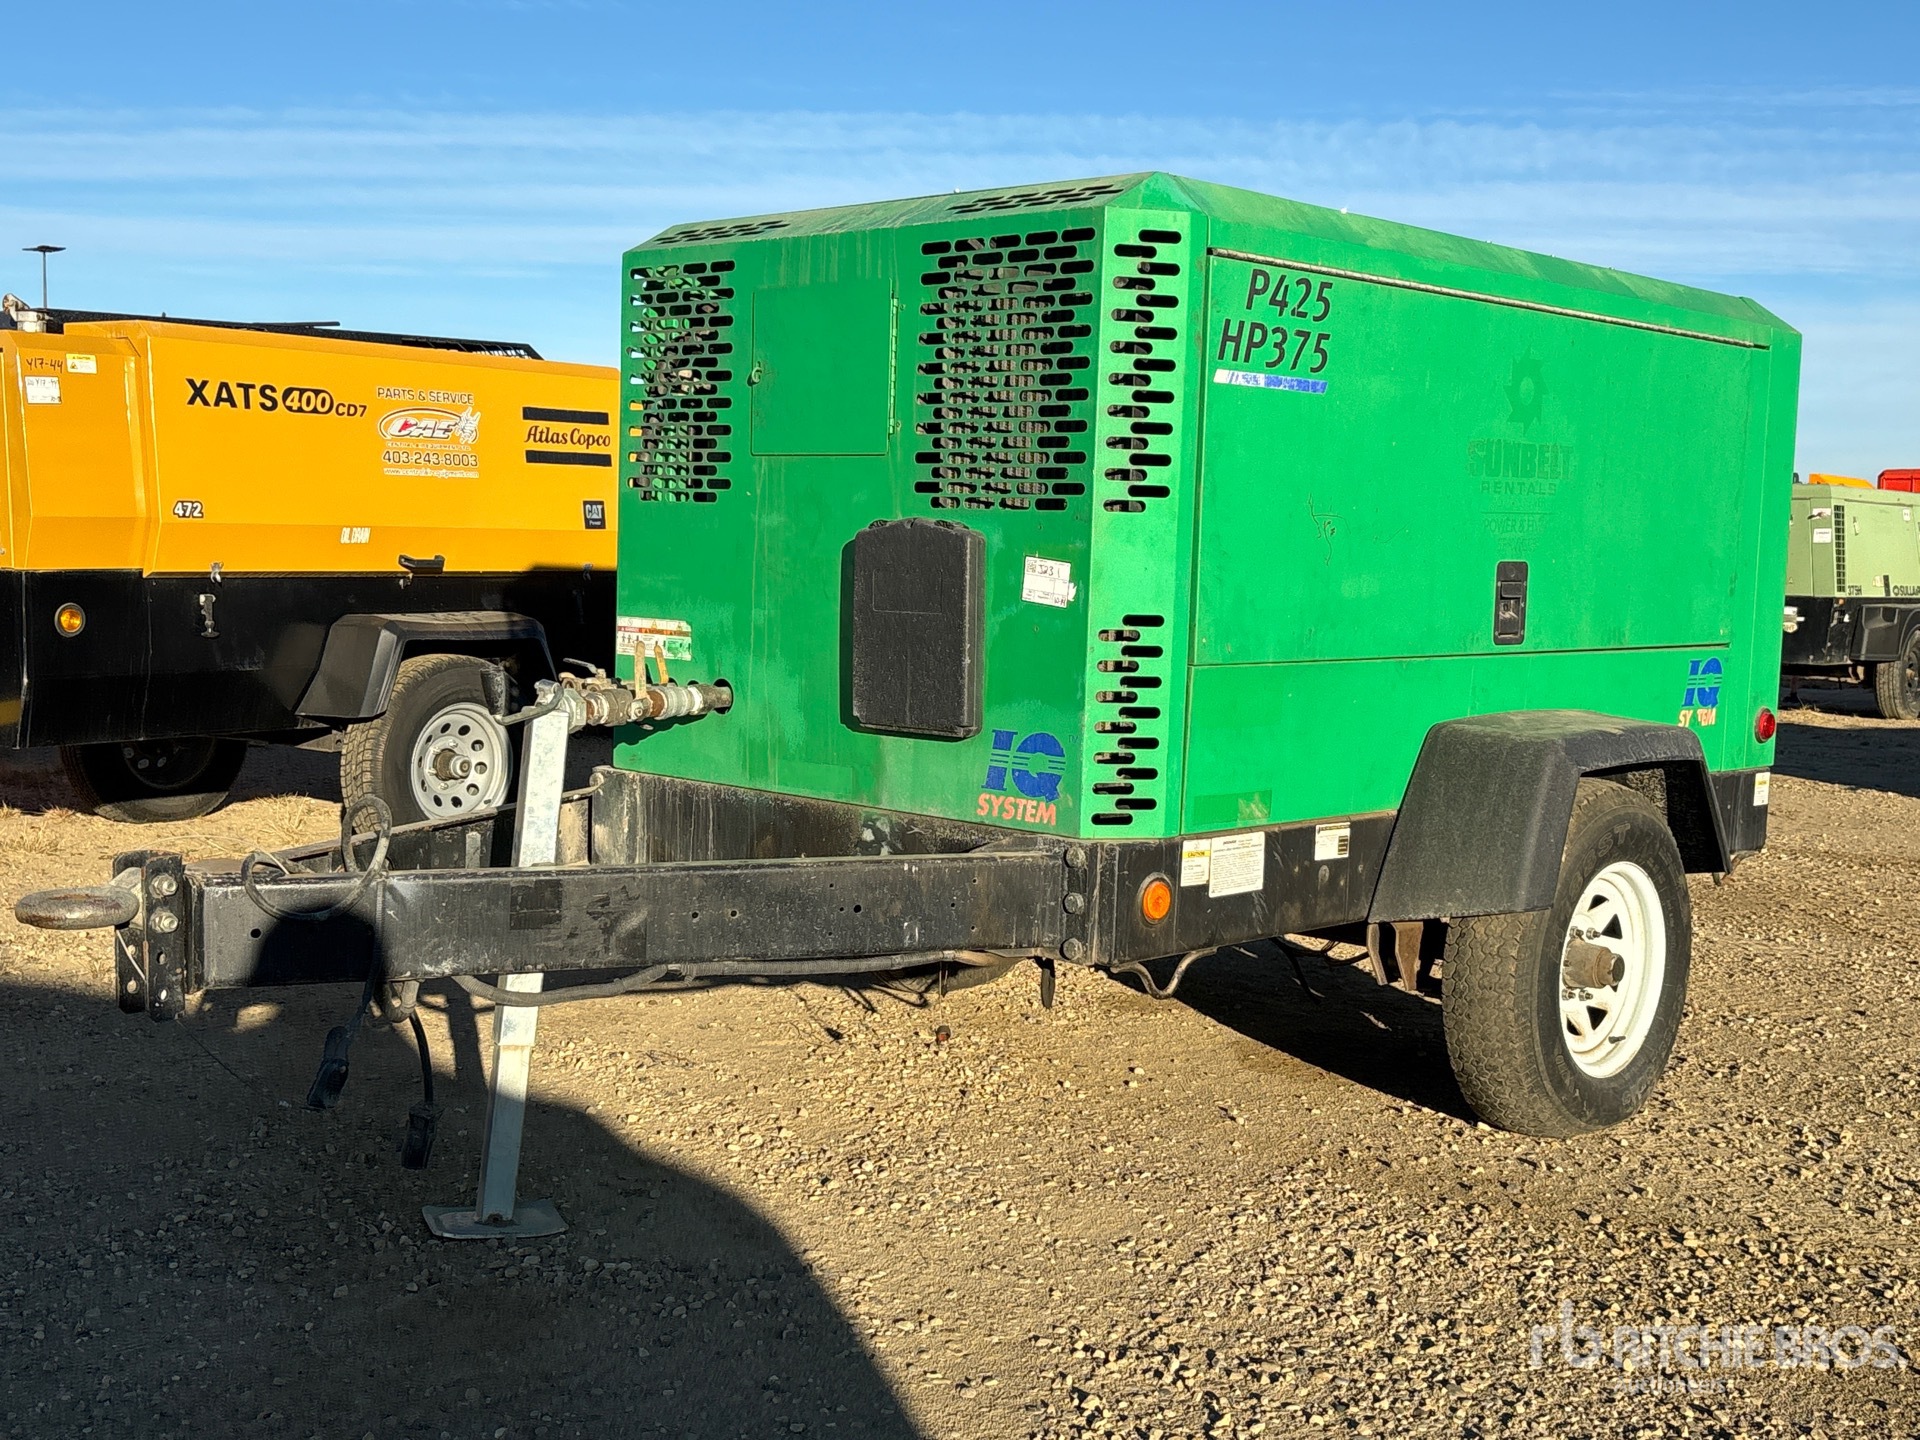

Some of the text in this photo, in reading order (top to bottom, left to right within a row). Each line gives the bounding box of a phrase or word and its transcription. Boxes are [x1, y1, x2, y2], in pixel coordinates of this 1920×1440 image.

[1245, 268, 1333, 322] P425
[1217, 318, 1331, 373] HP375
[185, 378, 368, 418] XATS 400 CD7
[377, 387, 474, 404] PARTS & SERVICE
[524, 425, 611, 450] Atlas Copco
[383, 450, 478, 467] 403-243-8003
[1466, 438, 1575, 480] SUNBELT
[1480, 480, 1557, 496] RENTALS
[173, 500, 204, 518] 472
[585, 504, 603, 519] CAT
[1681, 657, 1723, 709] IQ
[1677, 707, 1717, 728] SYTEM
[980, 728, 1067, 804] IQ
[976, 792, 1057, 827] SYSTEM
